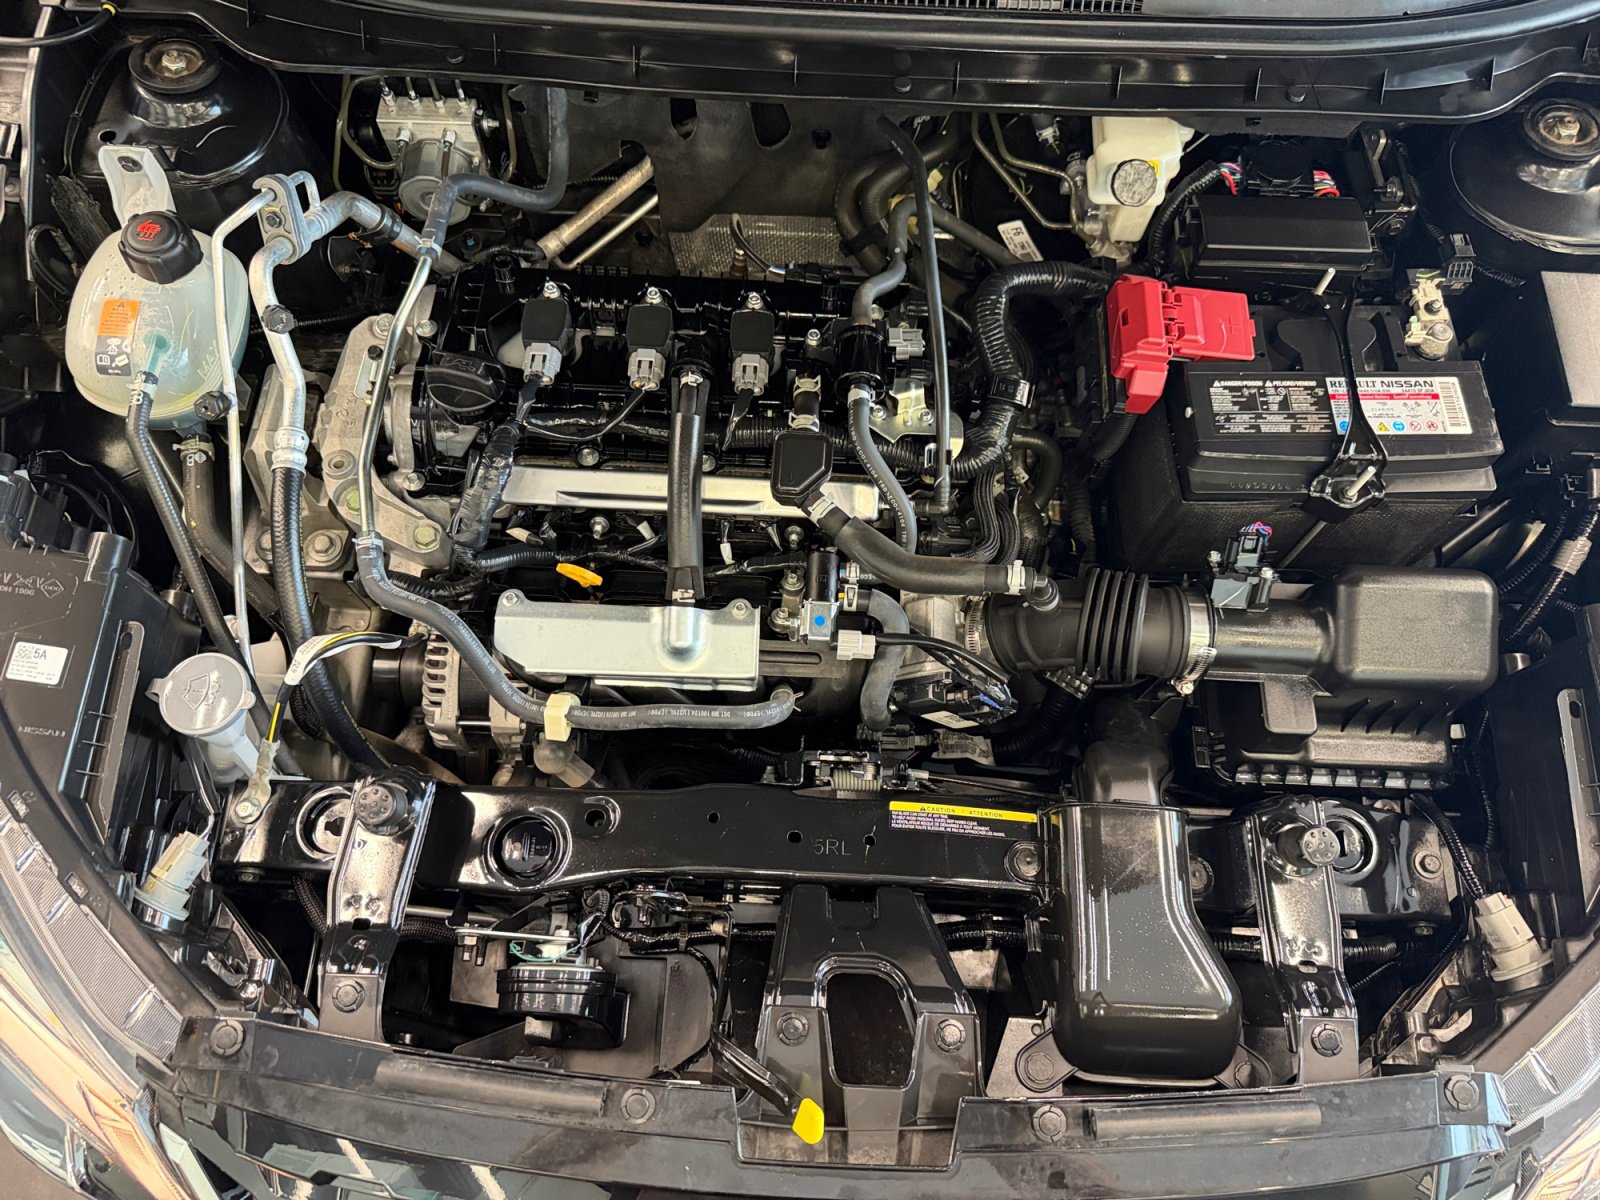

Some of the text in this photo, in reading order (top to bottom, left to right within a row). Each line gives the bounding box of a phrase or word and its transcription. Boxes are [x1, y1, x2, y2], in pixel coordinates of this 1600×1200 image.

[33, 648, 47, 660] 5A
[18, 726, 66, 737] NISSAN
[814, 838, 852, 856] 5RL
